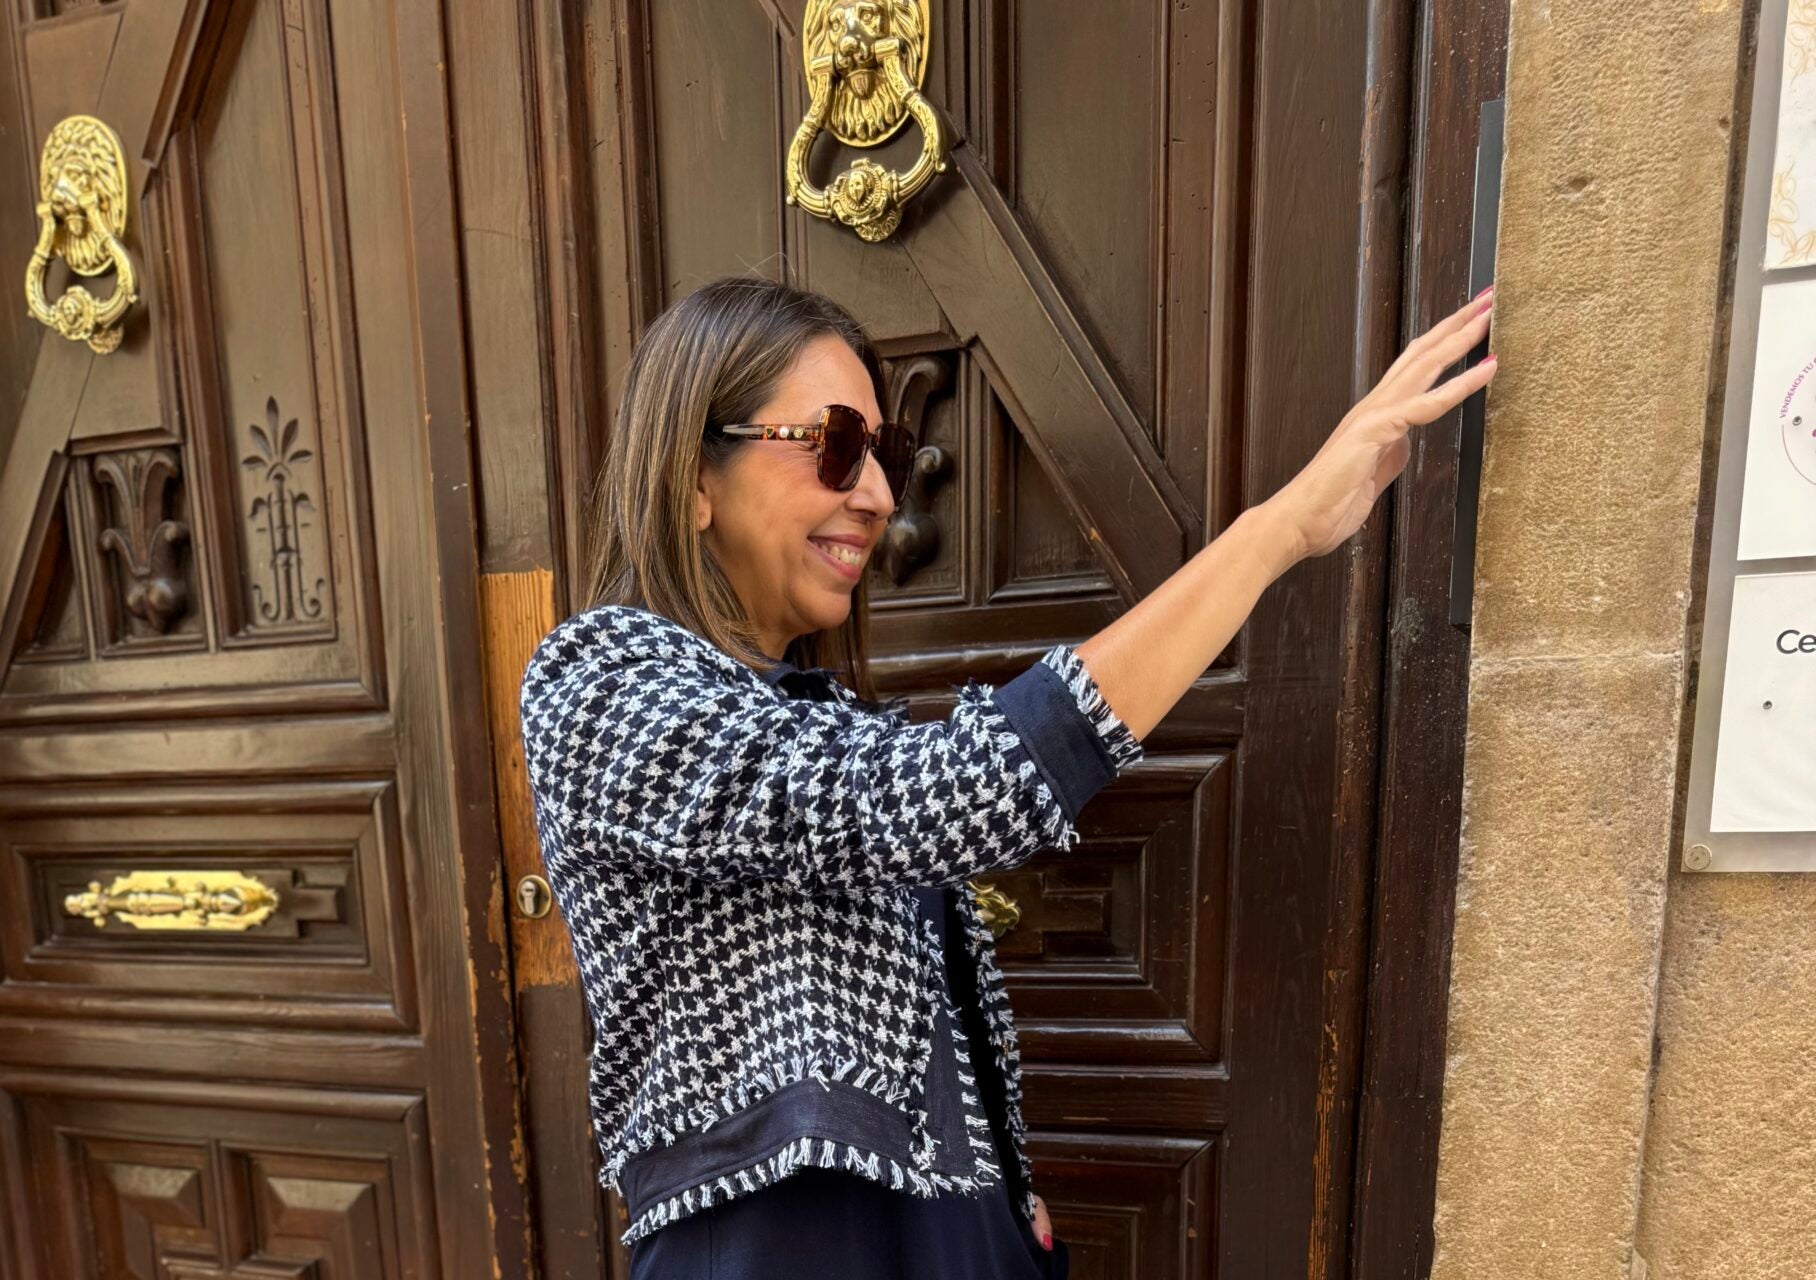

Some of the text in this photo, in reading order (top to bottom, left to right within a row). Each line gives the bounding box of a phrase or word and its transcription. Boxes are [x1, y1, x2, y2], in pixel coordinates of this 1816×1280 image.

[1779, 362, 1814, 419] VENDEMOS TU
[1776, 629, 1816, 655] Ce
